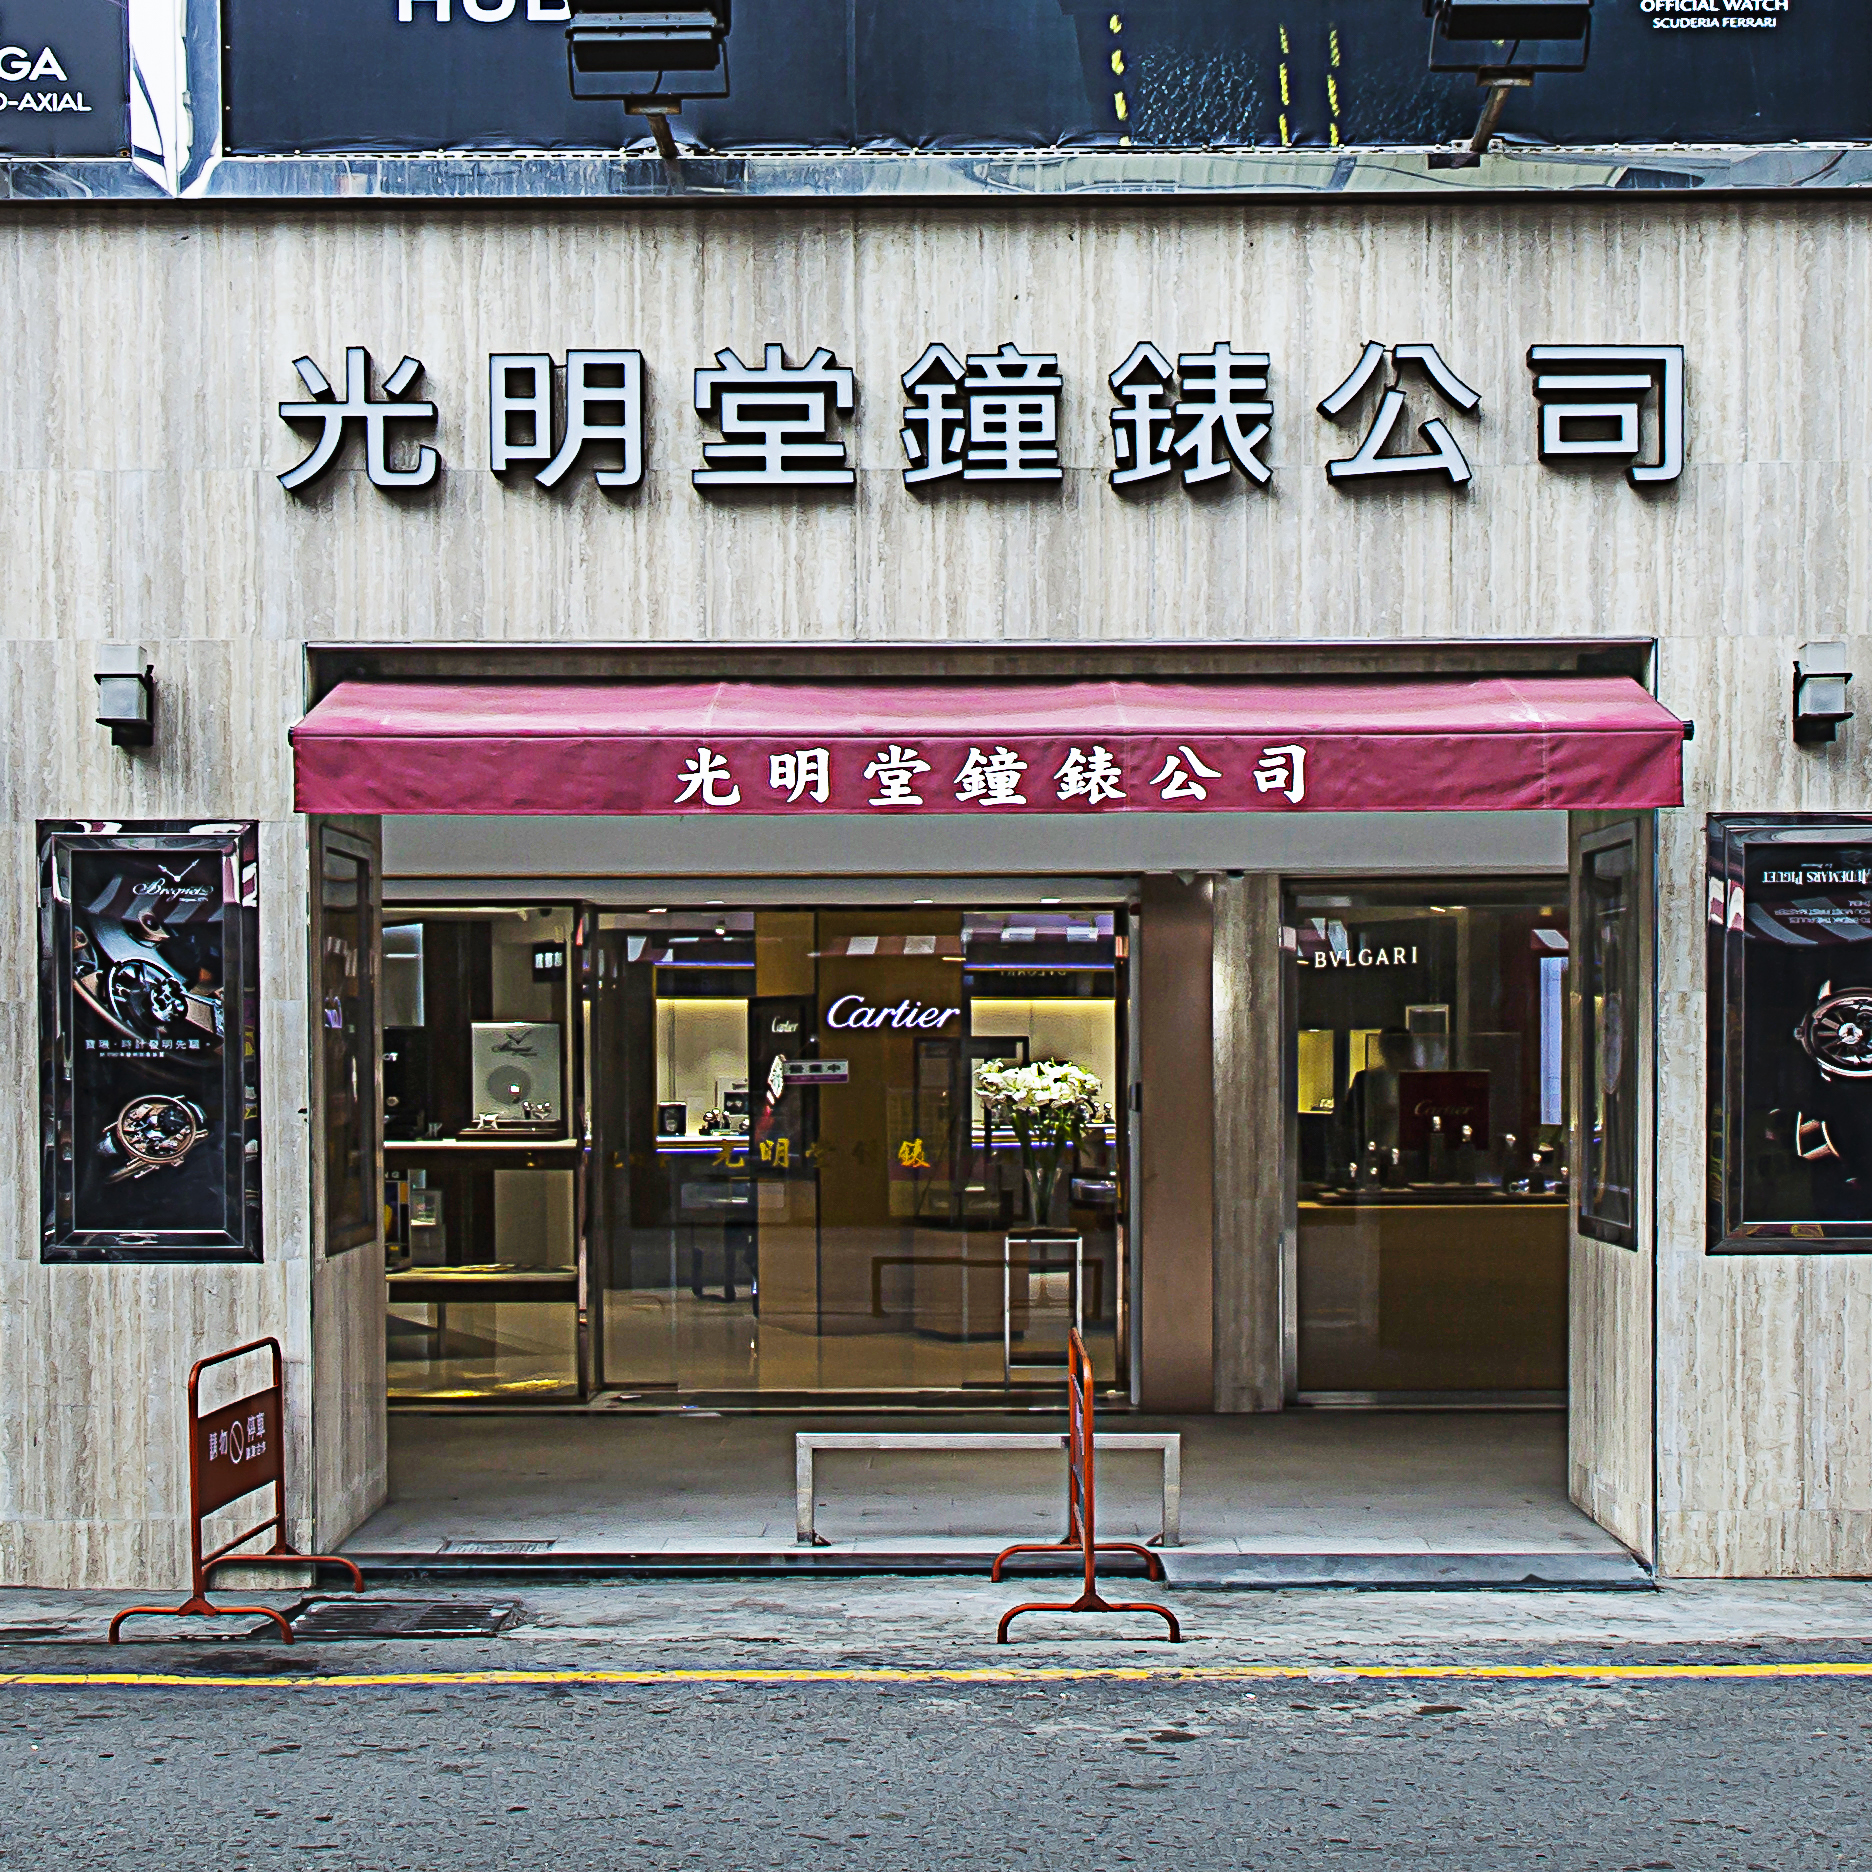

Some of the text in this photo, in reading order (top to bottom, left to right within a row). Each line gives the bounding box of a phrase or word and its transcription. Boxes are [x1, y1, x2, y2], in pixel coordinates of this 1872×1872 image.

[1652, 16, 1778, 30] SCUDERIA FERRARI
[277, 341, 1688, 490] 光明堂鐘錶公司
[673, 742, 1309, 808] 光明堂鐘錶公司
[1761, 867, 1872, 886] AUDEMARS PIGUET
[1314, 946, 1419, 970] BVLGARI
[826, 994, 961, 1029] Cartier
